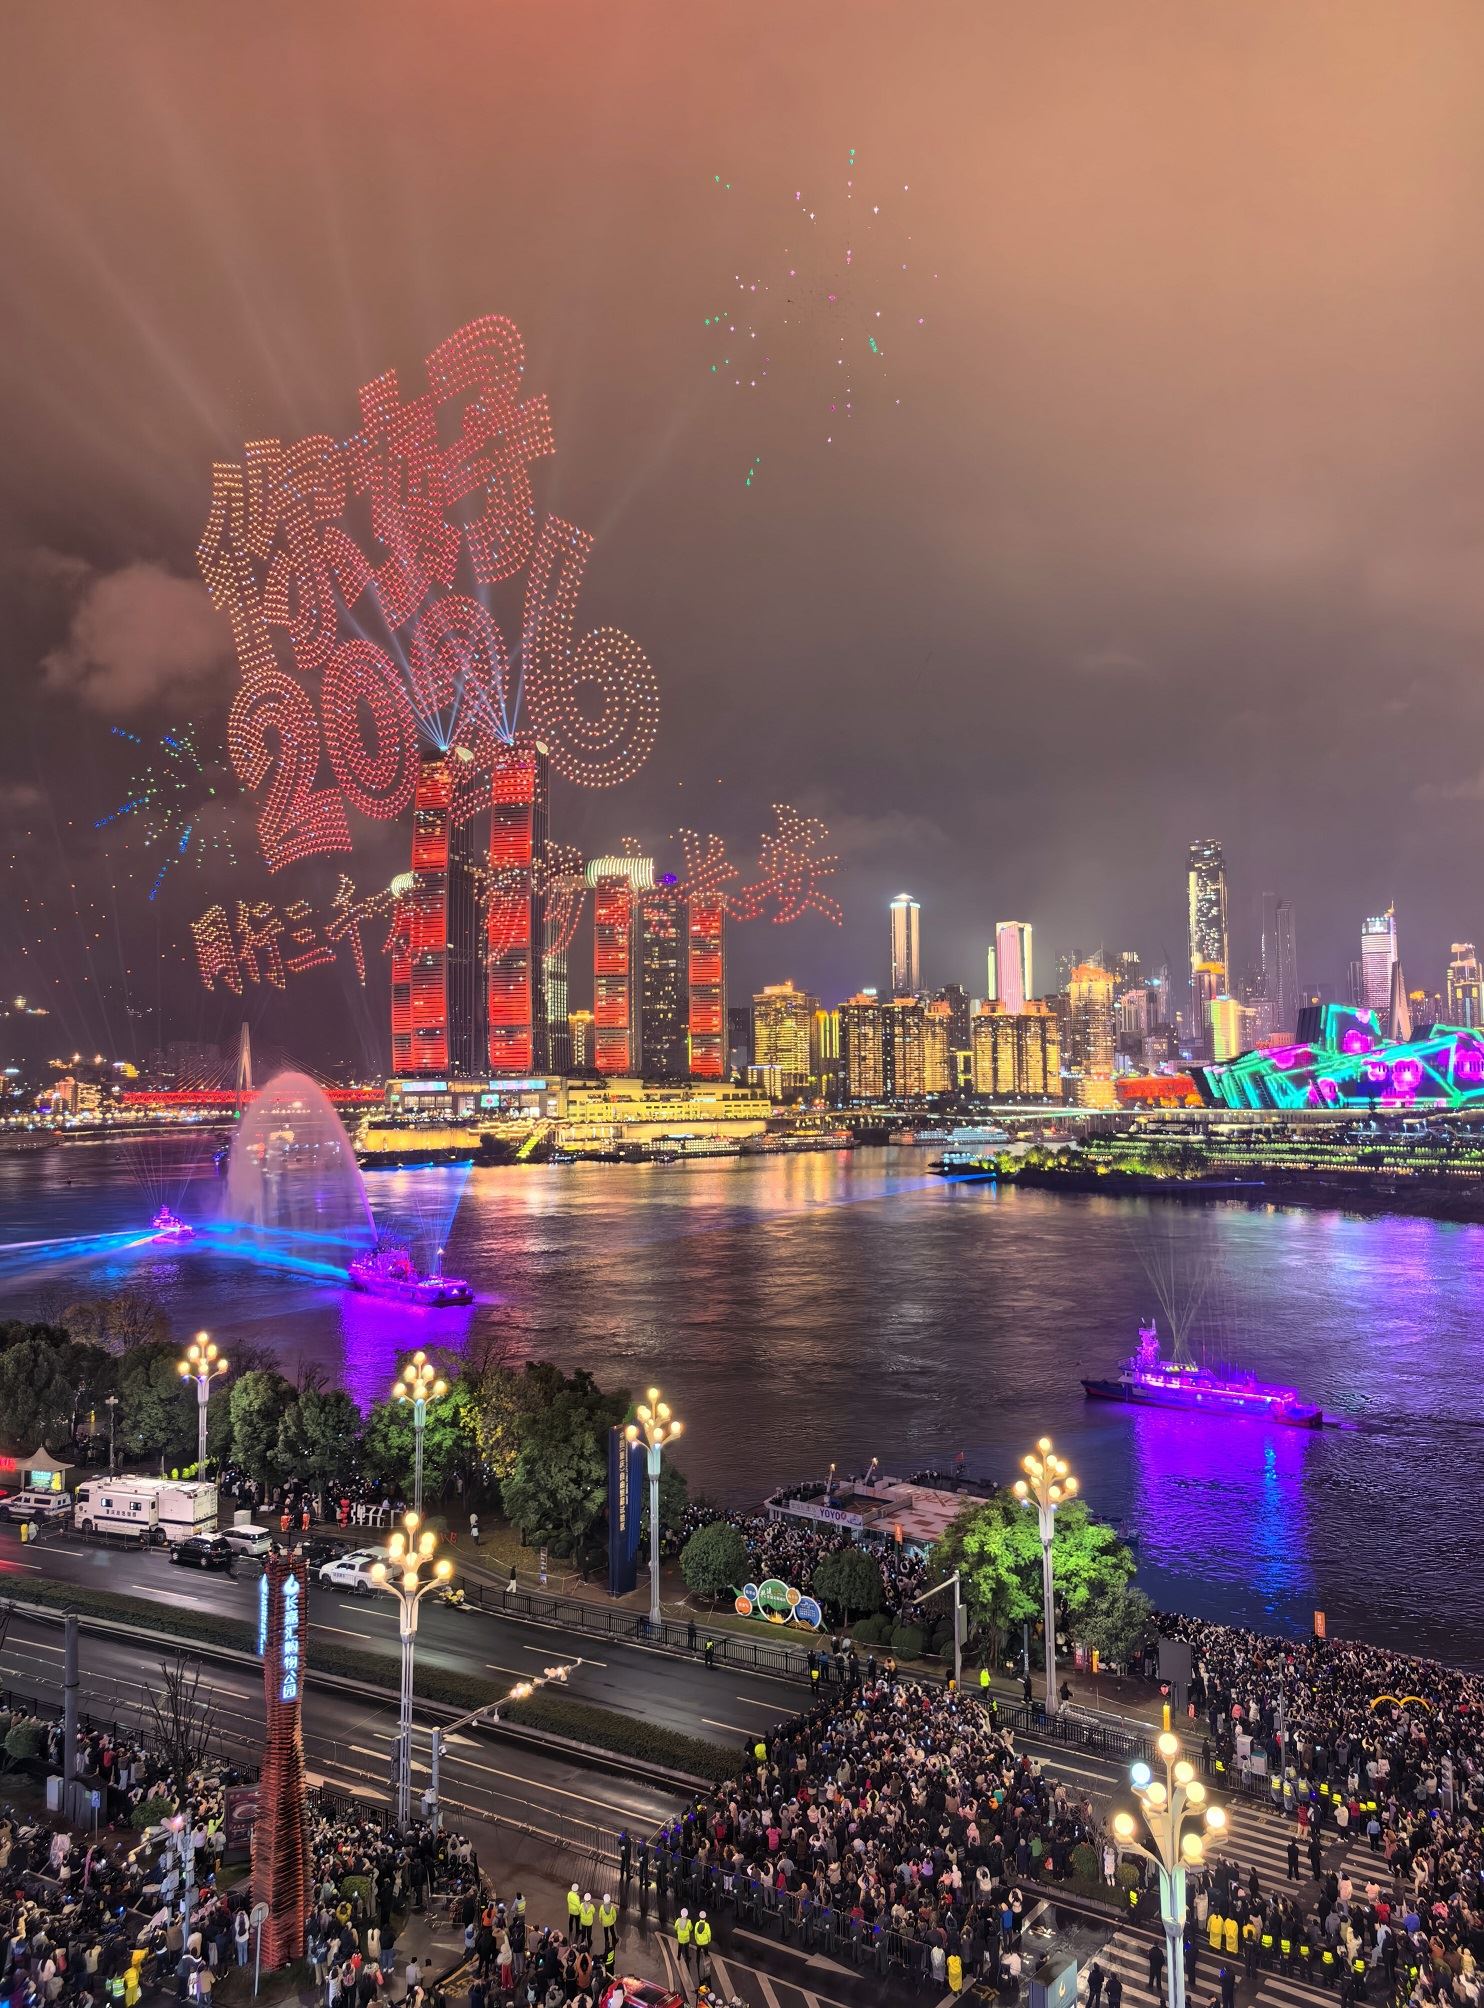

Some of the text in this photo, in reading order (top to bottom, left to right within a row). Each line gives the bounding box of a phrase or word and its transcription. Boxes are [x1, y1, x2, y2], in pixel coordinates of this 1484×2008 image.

[226, 512, 662, 877] 2026
[282, 1595, 299, 1699] 长嘉汇购物公园
